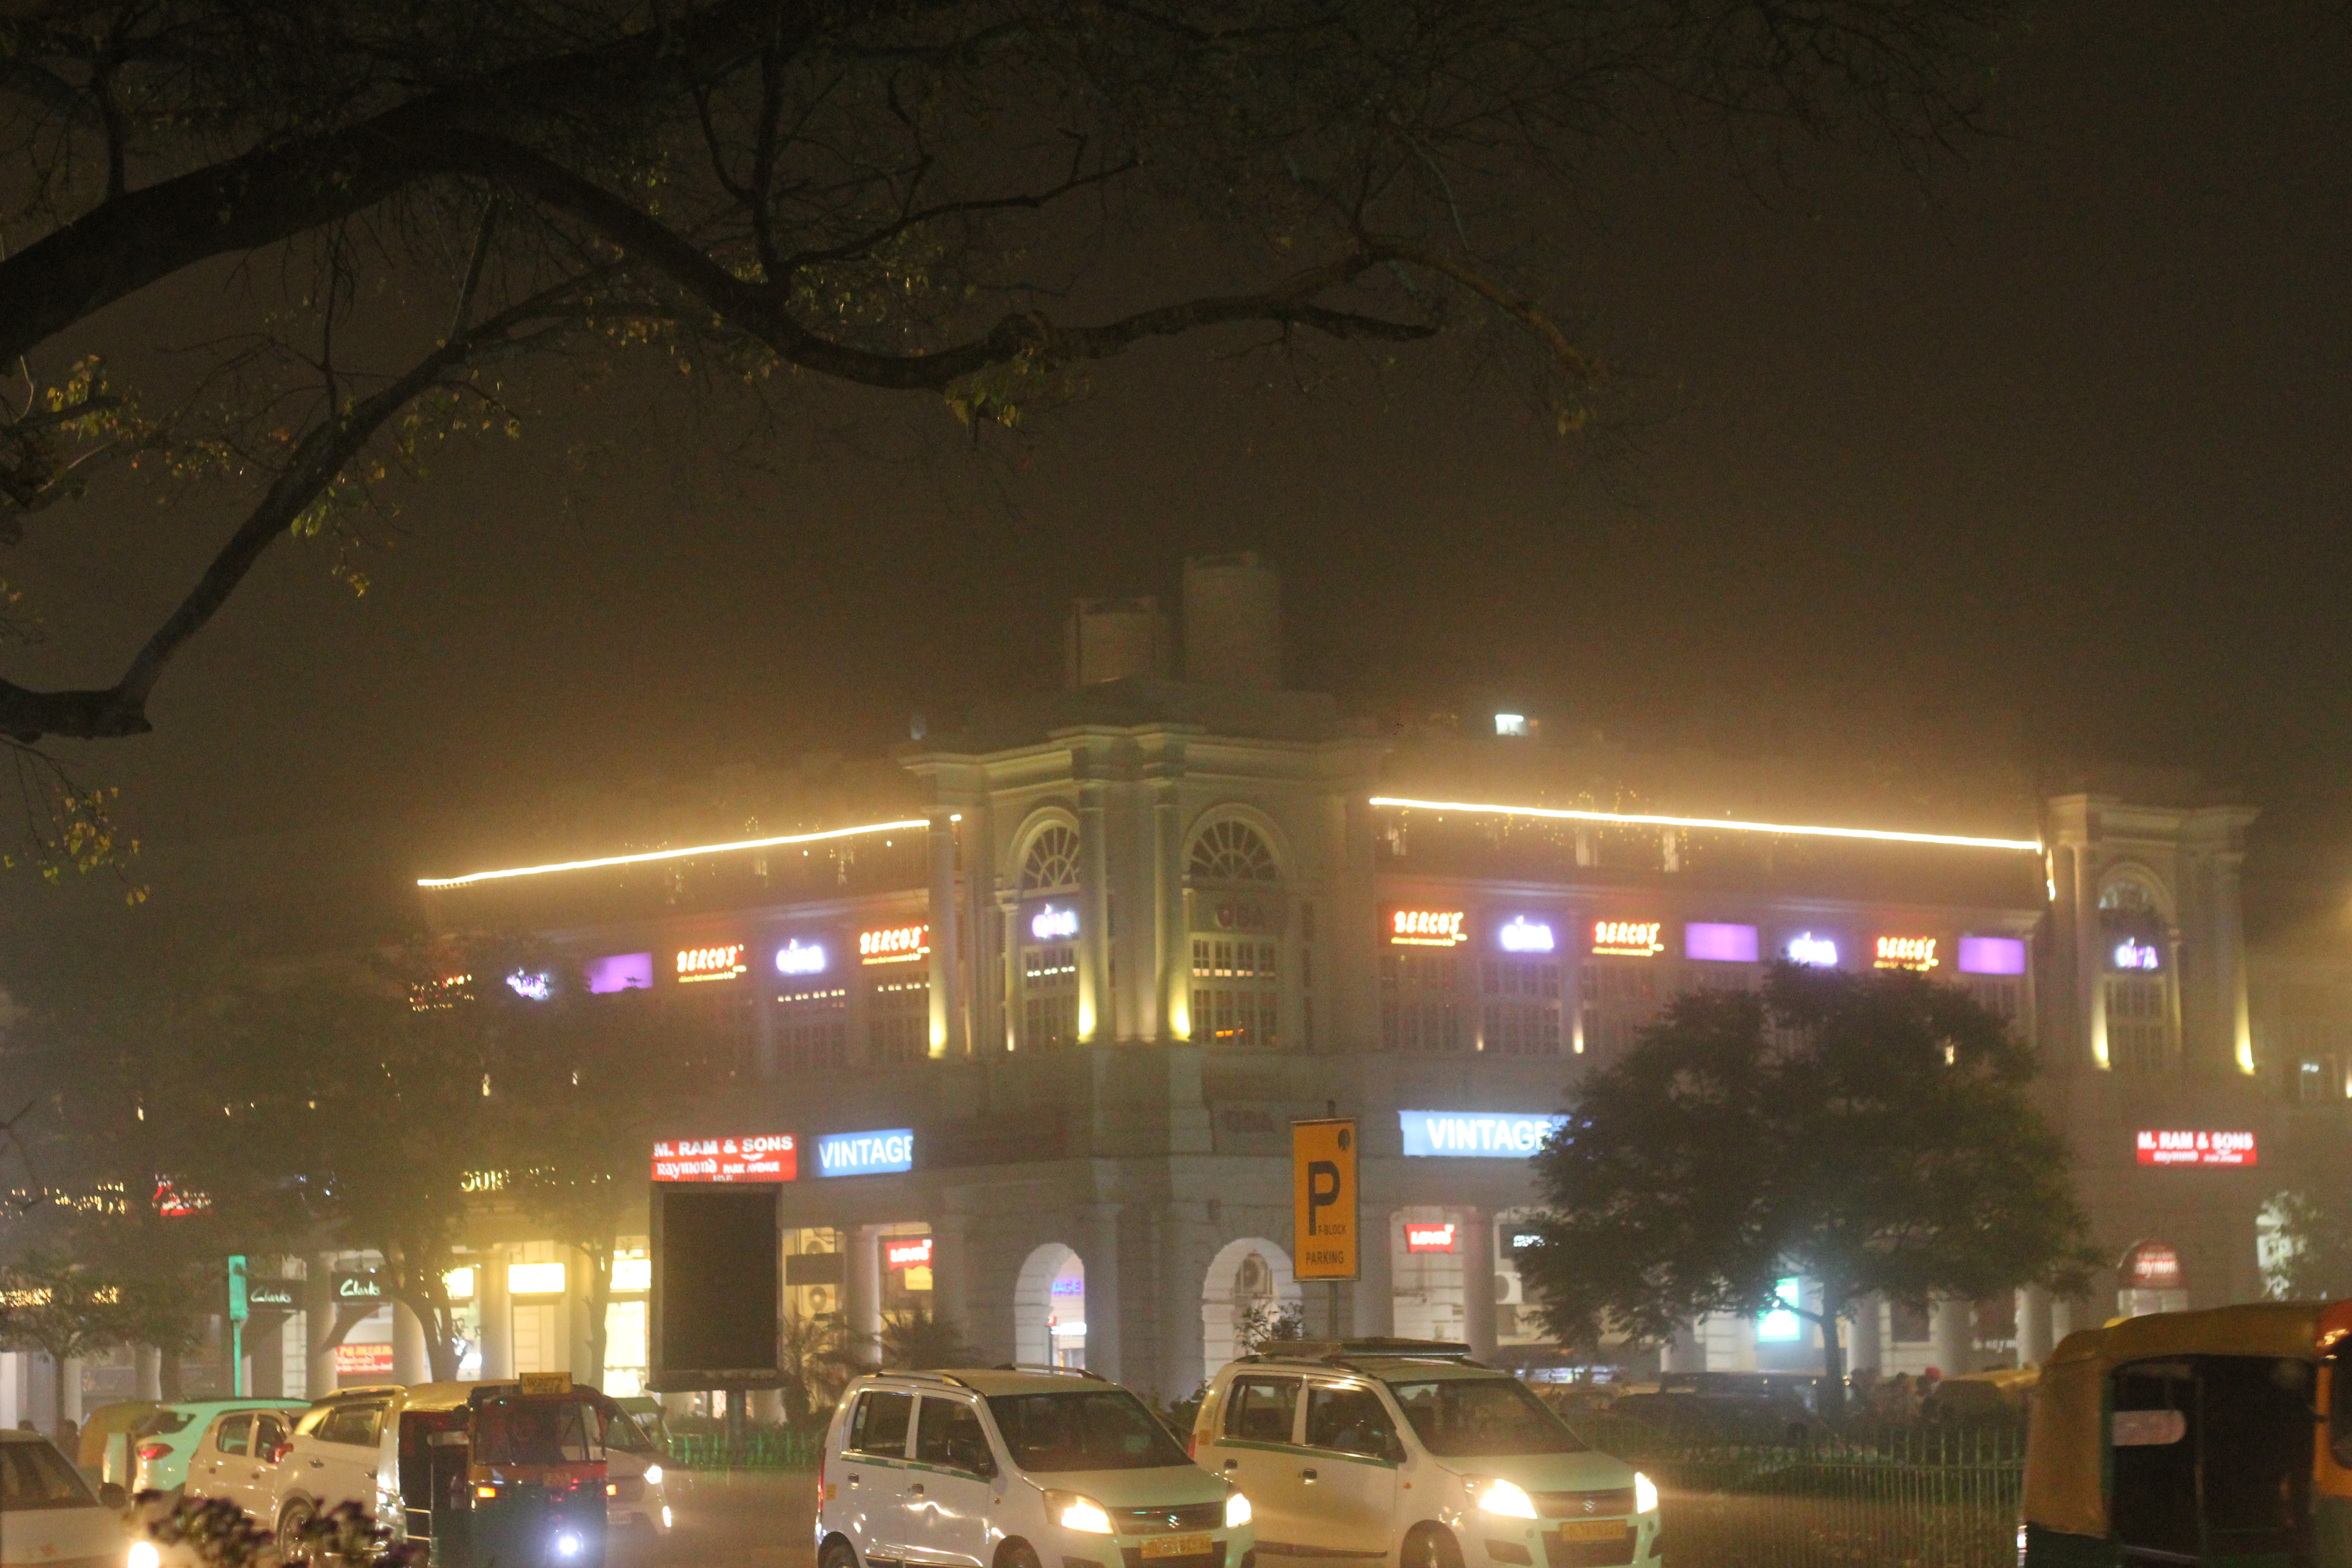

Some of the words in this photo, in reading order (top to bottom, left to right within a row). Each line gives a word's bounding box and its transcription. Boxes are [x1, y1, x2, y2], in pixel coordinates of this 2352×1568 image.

[679, 1140, 719, 1156] RAM
[723, 1139, 738, 1154] &
[742, 1136, 793, 1152] SONS
[2159, 1131, 2193, 1150] RAM
[2196, 1131, 2209, 1150] &
[2212, 1132, 2254, 1150] SONS
[818, 1135, 914, 1168] VINTAGE
[657, 1158, 717, 1179] Raymond
[723, 1163, 745, 1174] PARK
[746, 1161, 780, 1173] AVENUE
[1308, 1161, 1341, 1236] P
[1306, 1250, 1344, 1265] PARKING
